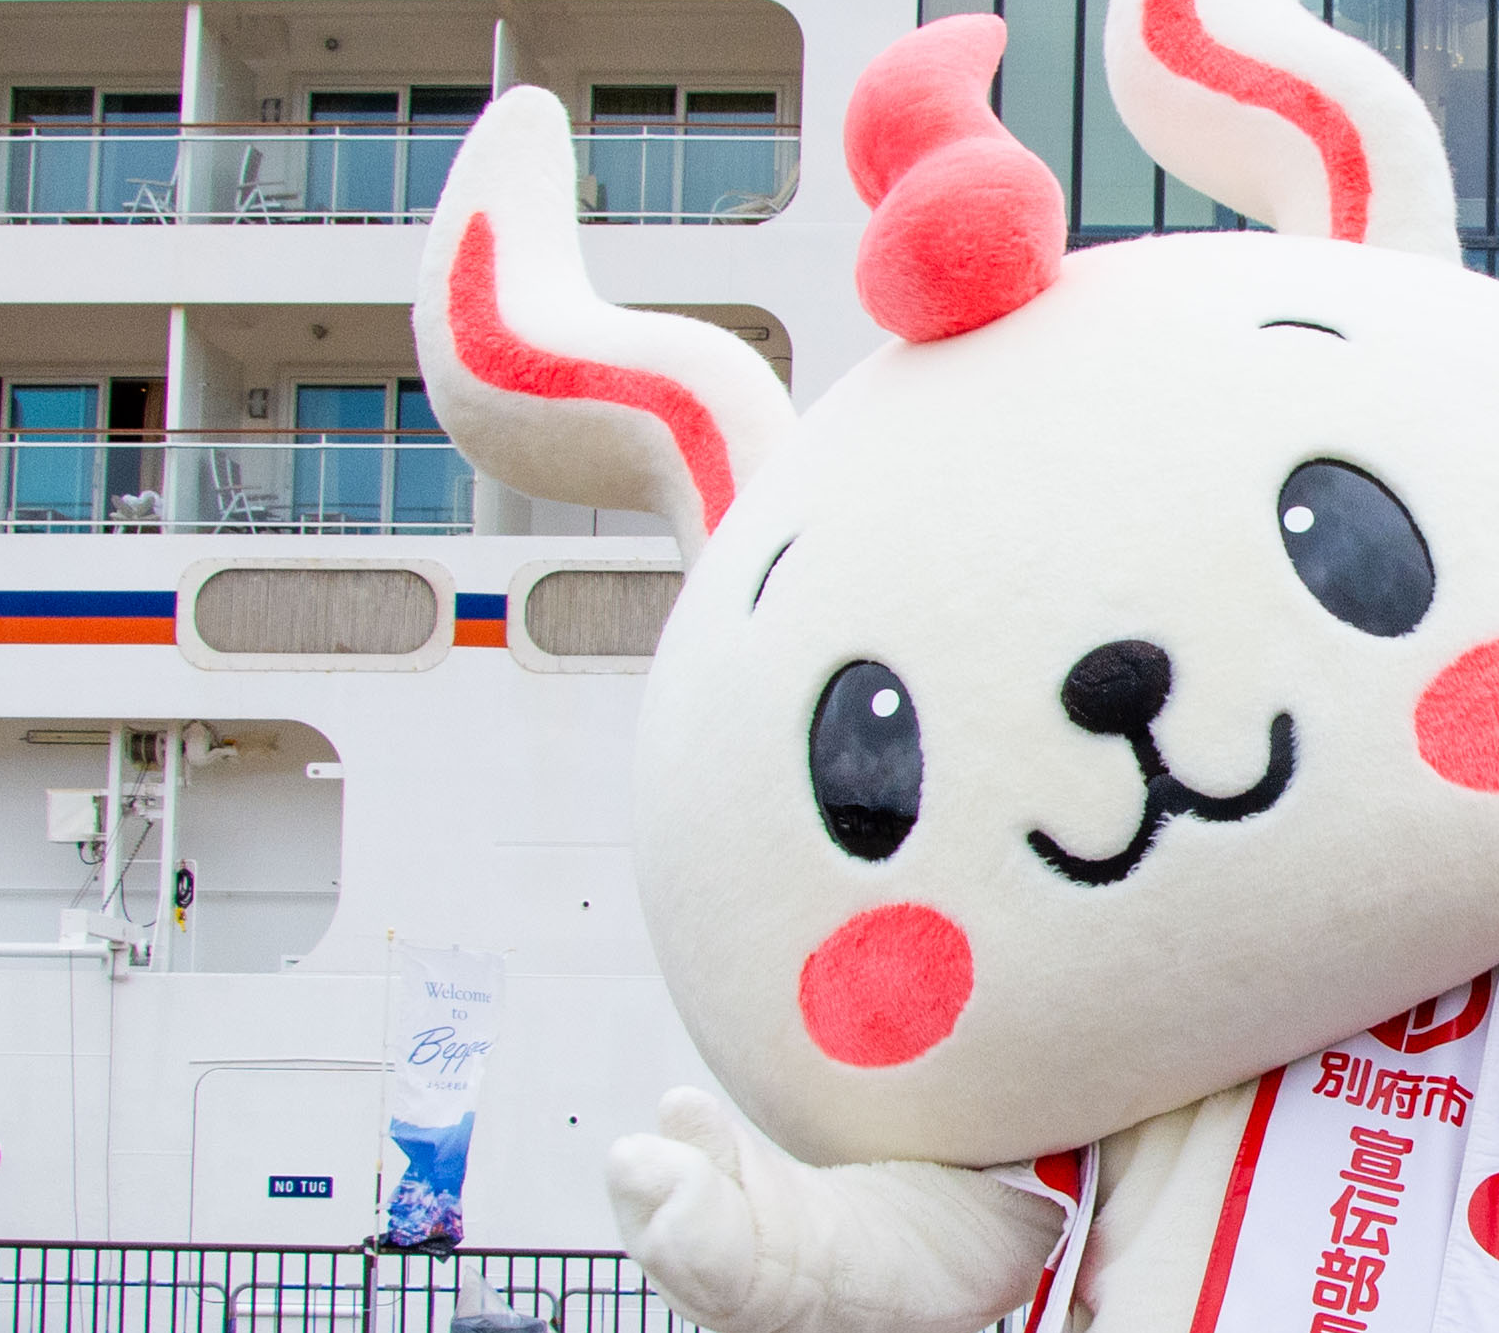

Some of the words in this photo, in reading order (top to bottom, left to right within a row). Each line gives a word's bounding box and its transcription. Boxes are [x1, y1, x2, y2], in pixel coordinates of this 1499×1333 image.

[425, 981, 492, 1003] Welcome
[452, 1008, 469, 1021] to
[1312, 1051, 1474, 1128] 別府市
[274, 1180, 293, 1193] NO
[300, 1180, 326, 1193] TUG
